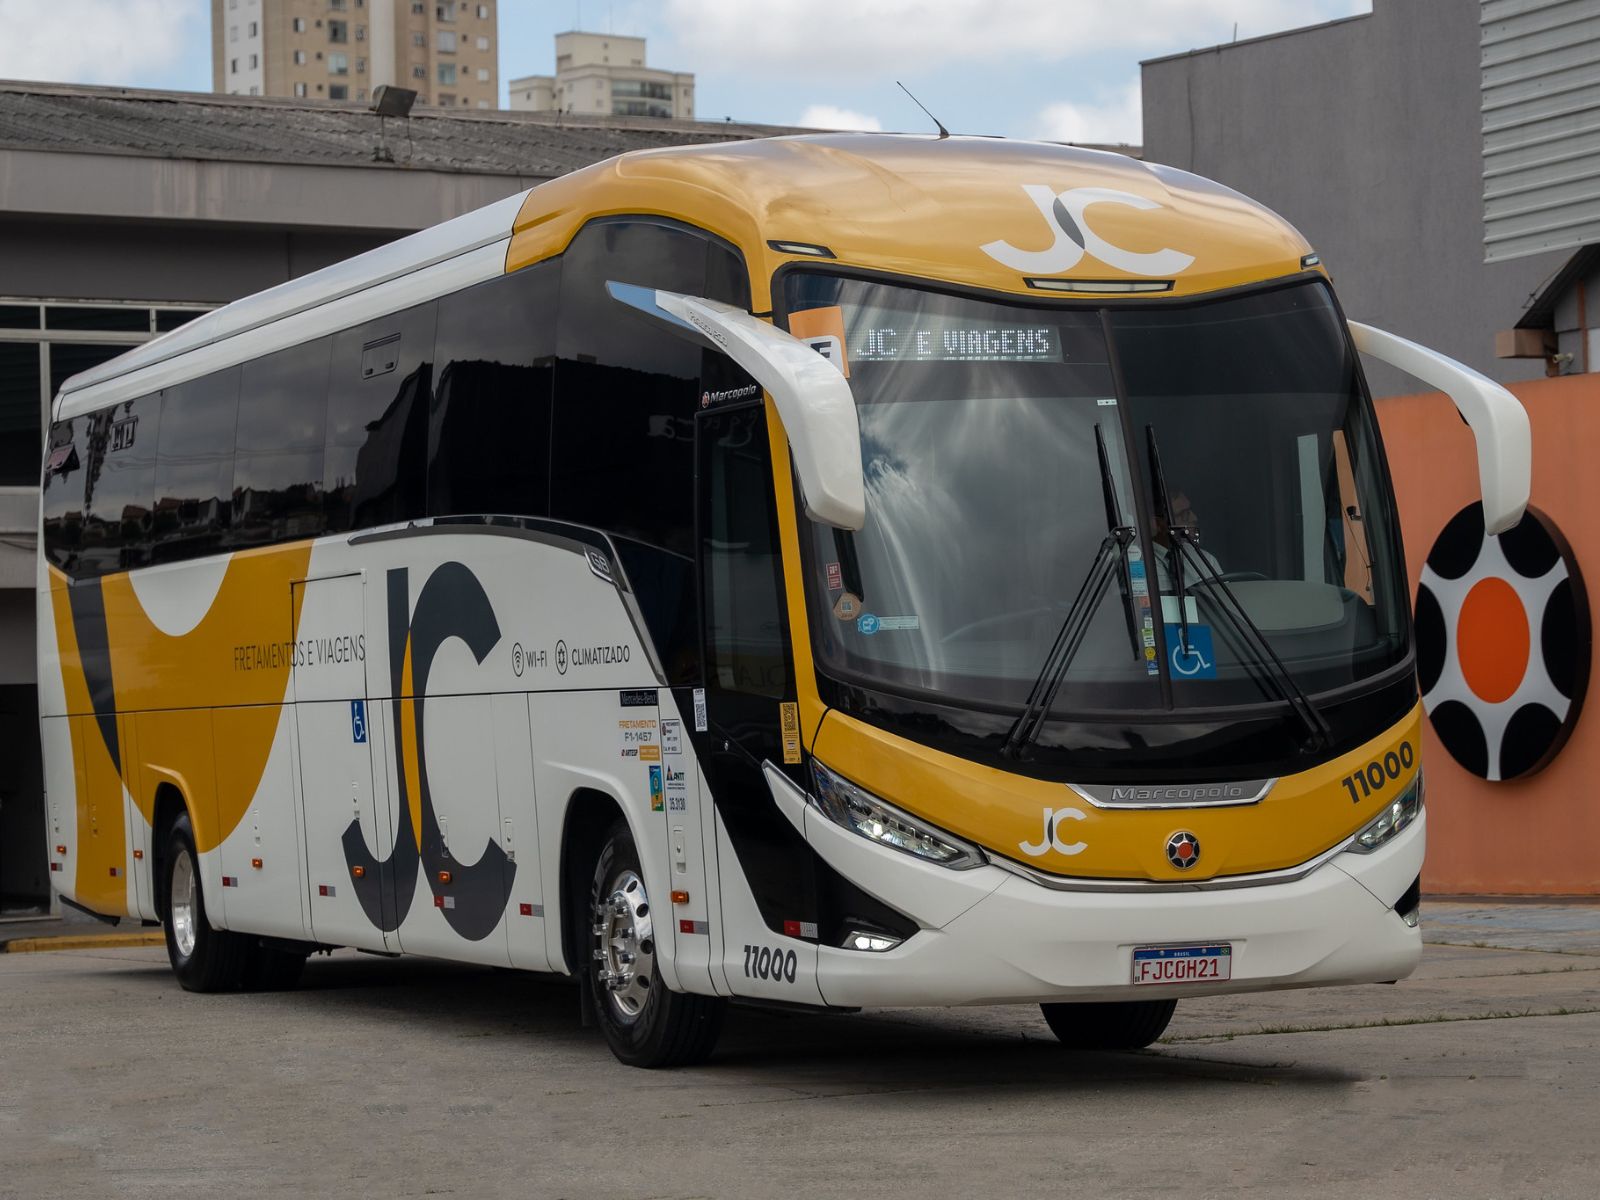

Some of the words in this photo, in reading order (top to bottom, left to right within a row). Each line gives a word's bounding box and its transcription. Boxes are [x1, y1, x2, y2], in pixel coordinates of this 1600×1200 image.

[979, 184, 1196, 276] JC
[856, 328, 896, 355] JC
[917, 331, 931, 354] E
[943, 328, 1049, 354] VIAGENS
[710, 384, 757, 403] Marcopolo
[234, 640, 305, 672] FRETAMENTOS
[307, 640, 314, 666] E
[315, 634, 366, 665] VIAGENS
[525, 650, 548, 669] WI-FI
[571, 645, 631, 667] CLIMATIZADO
[619, 720, 657, 729] FRETAMENTO
[624, 731, 653, 742] F1-1457
[1341, 740, 1414, 805] 11000
[1111, 784, 1243, 803] Marcopolo
[1018, 807, 1088, 856] JC
[743, 945, 798, 984] 11000
